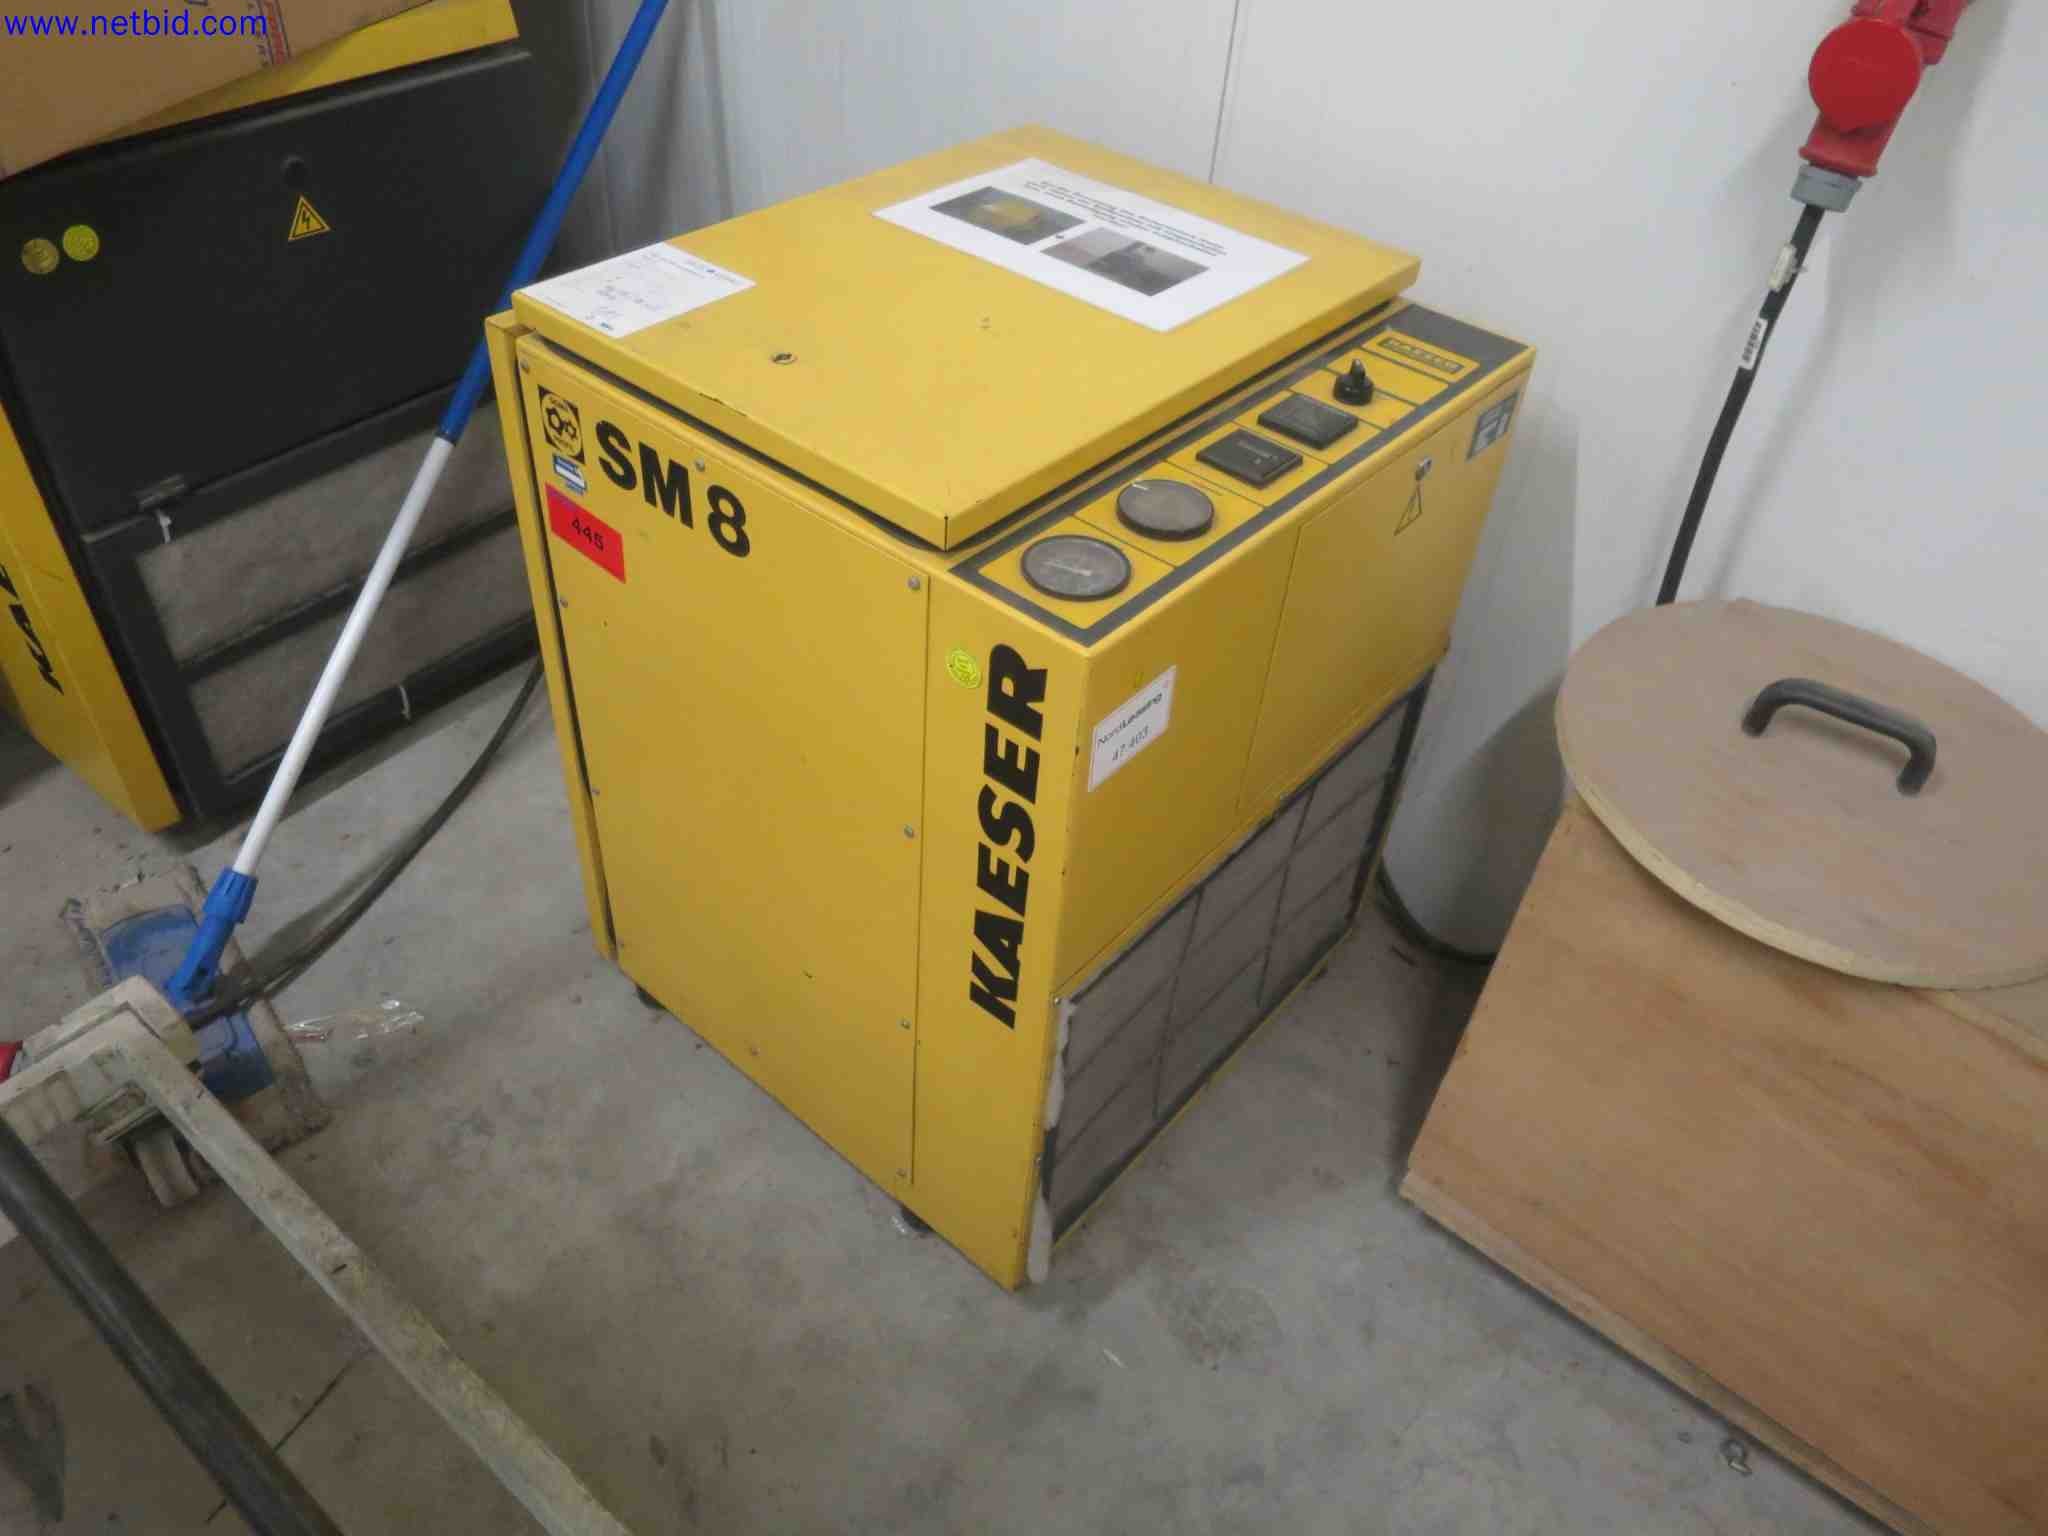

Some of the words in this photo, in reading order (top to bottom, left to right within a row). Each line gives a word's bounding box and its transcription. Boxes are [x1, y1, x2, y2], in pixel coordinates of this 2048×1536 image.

[571, 516, 605, 552] 445
[595, 420, 693, 529] SM
[707, 484, 750, 558] 8
[969, 643, 1048, 1030] KAESER
